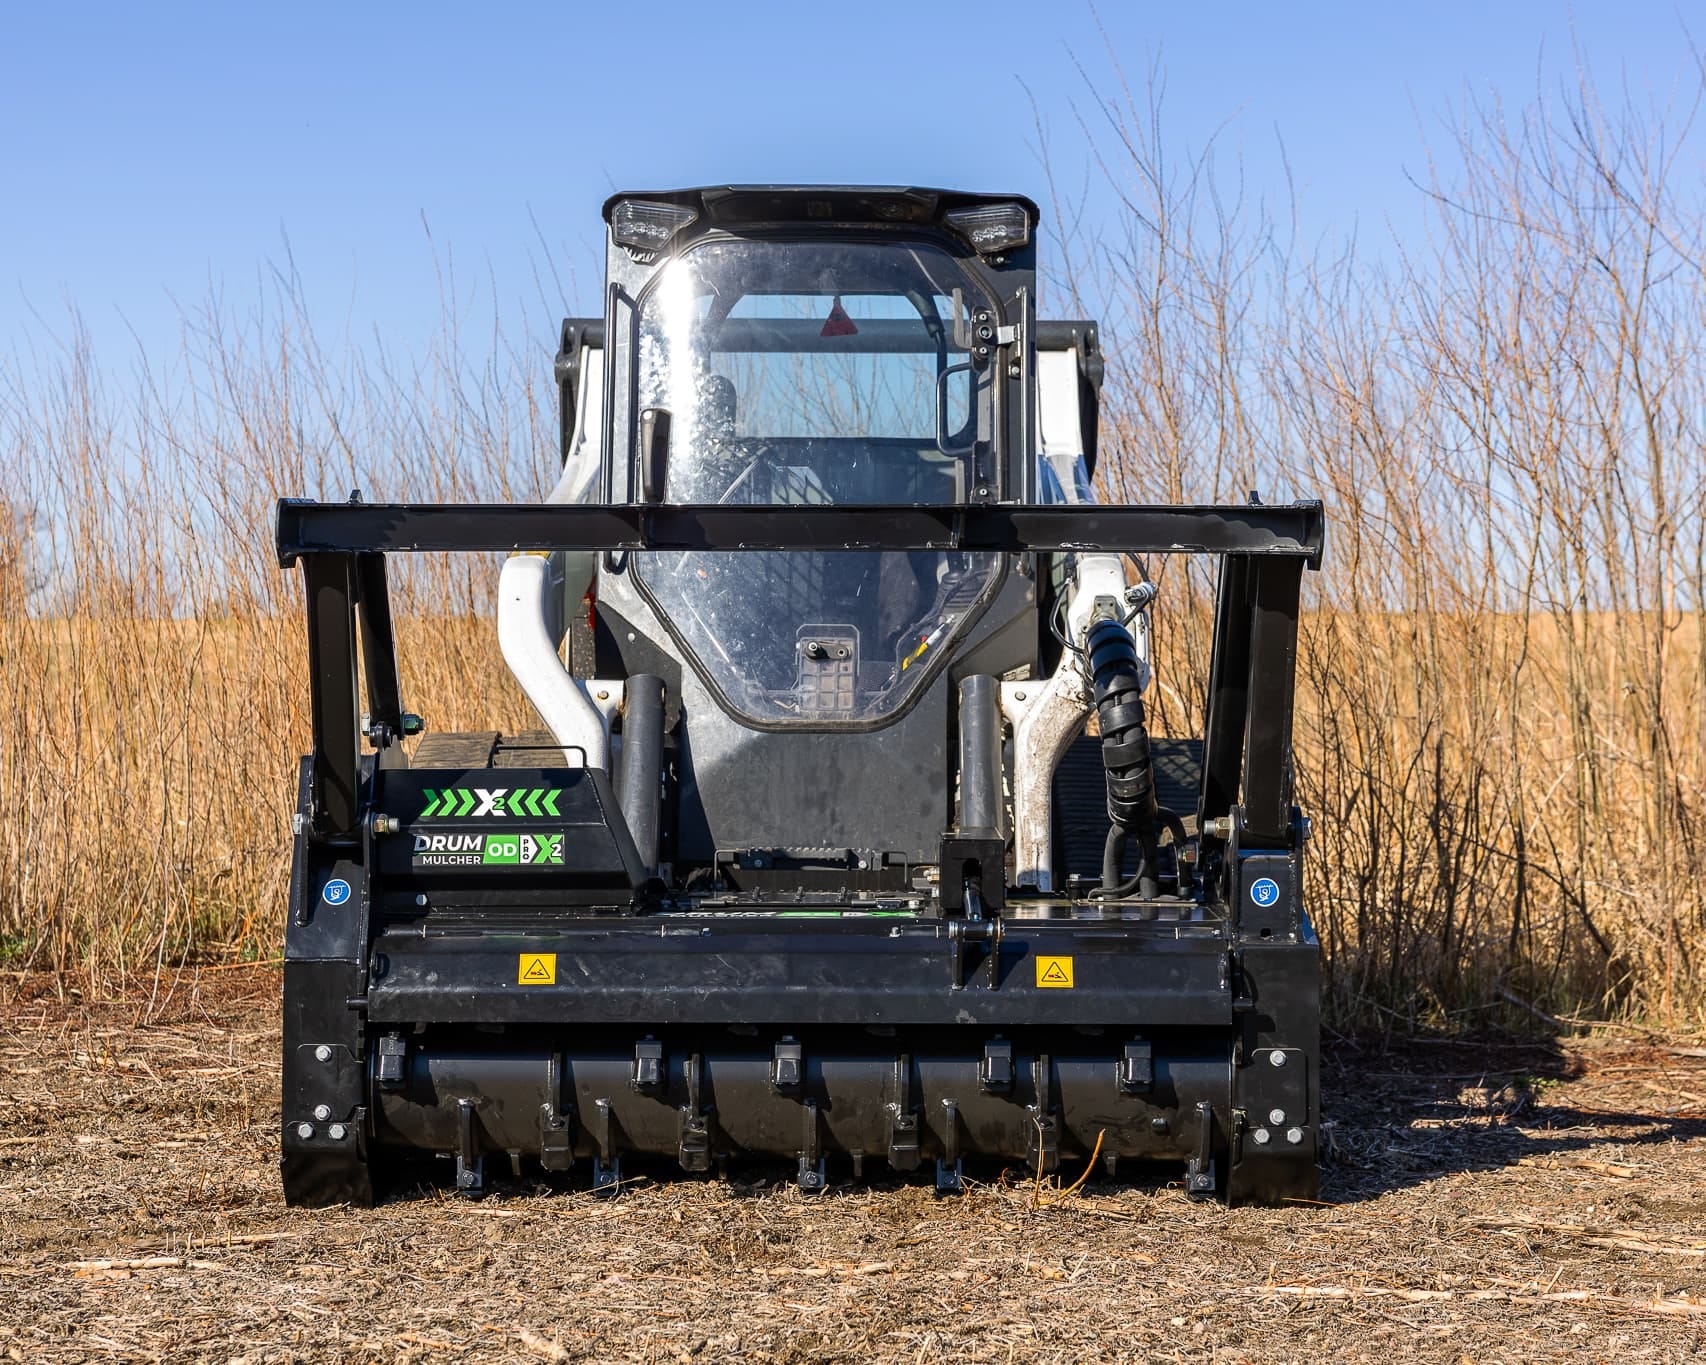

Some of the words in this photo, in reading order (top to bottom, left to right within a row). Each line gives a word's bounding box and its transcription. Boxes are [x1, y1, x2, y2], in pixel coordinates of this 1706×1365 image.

[413, 835, 483, 852] DRUM
[488, 843, 517, 857] OD
[422, 856, 481, 865] MULCHER
